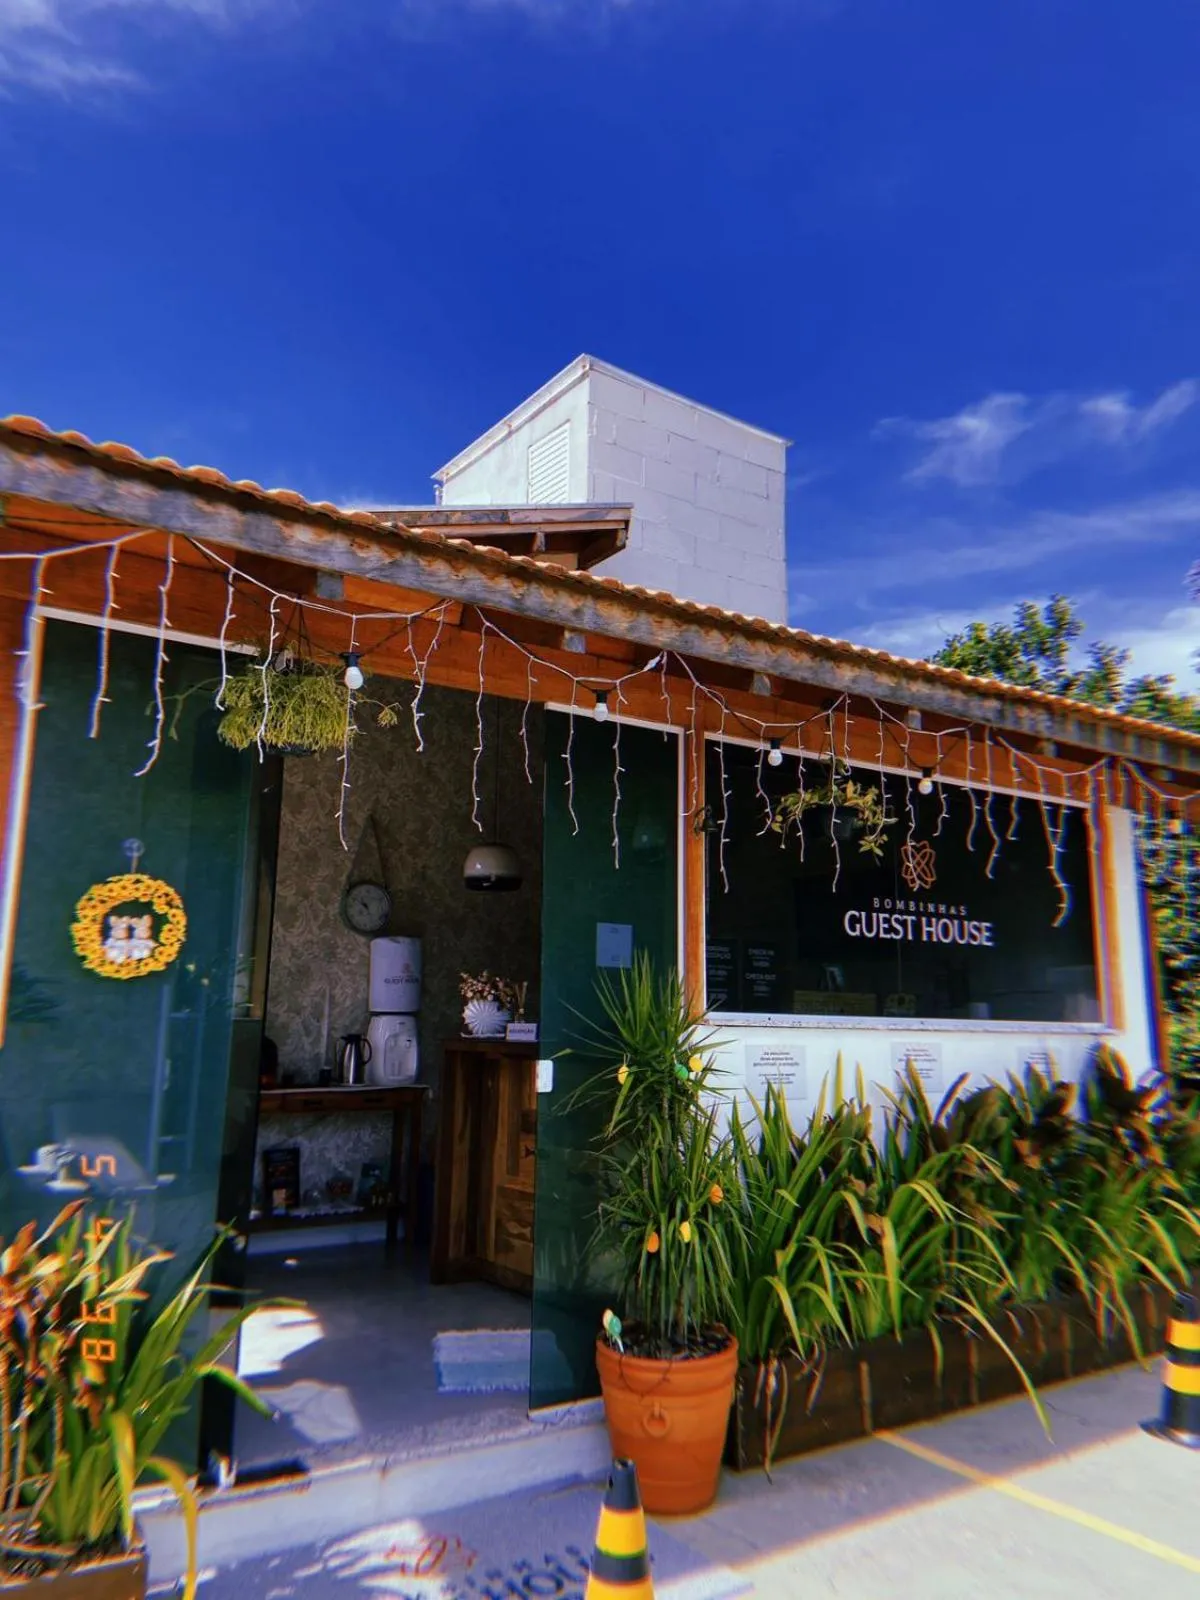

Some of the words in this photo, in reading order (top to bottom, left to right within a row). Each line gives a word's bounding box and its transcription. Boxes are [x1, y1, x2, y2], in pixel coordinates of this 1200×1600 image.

[873, 898, 967, 916] BOMBINHAS
[844, 910, 916, 941] GUEST
[921, 916, 994, 947] HOUSE
